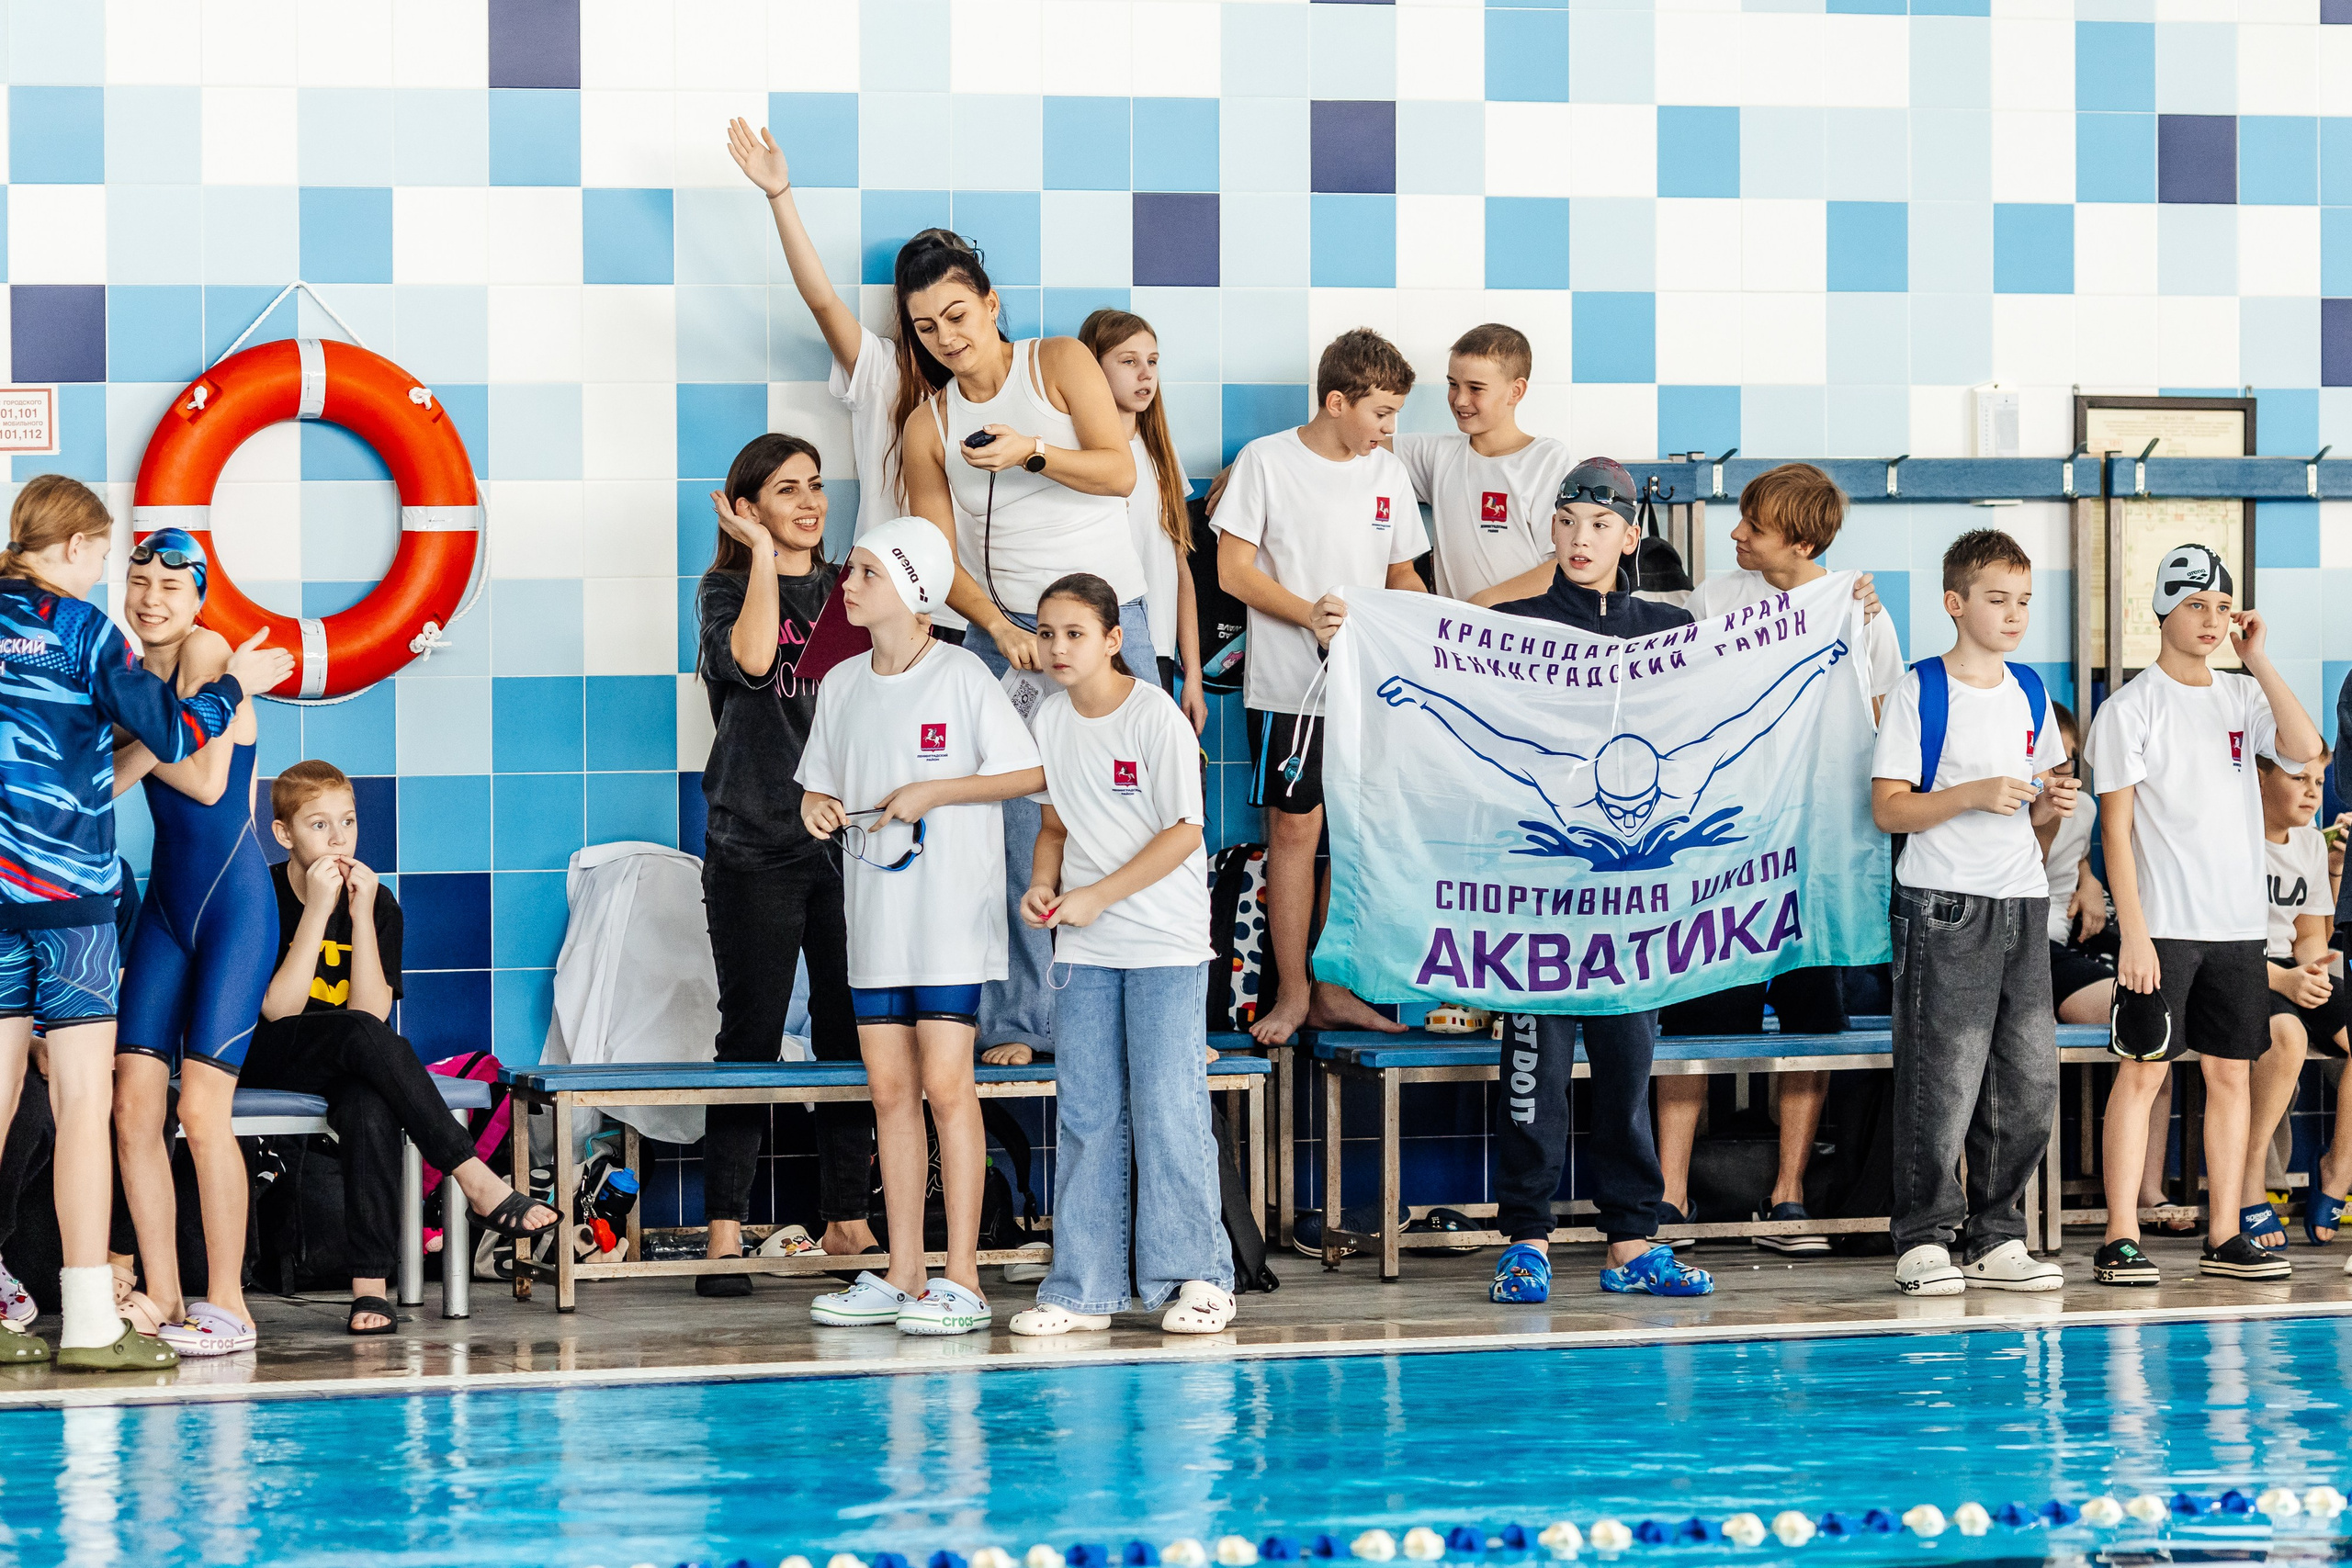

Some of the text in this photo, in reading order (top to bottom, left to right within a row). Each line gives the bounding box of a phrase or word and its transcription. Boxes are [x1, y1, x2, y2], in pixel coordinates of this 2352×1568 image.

[892, 547, 920, 584] arena
[1433, 608, 1808, 688] ЛЕНИНГРАДСКИЙ РАЙОН
[1438, 617, 1699, 661] КРАСНОДАРСКИЙ
[1435, 846, 1798, 917] СПОРТИВНАЯ ШКОЛА
[2267, 874, 2307, 907] ILA
[1415, 889, 1804, 993] АКВАТИКА
[1511, 1013, 1538, 1049] ST
[1510, 1049, 1539, 1094] DO
[2245, 1209, 2272, 1223] speedo
[942, 1316, 974, 1327] crocs
[199, 1338, 234, 1348] crocs
